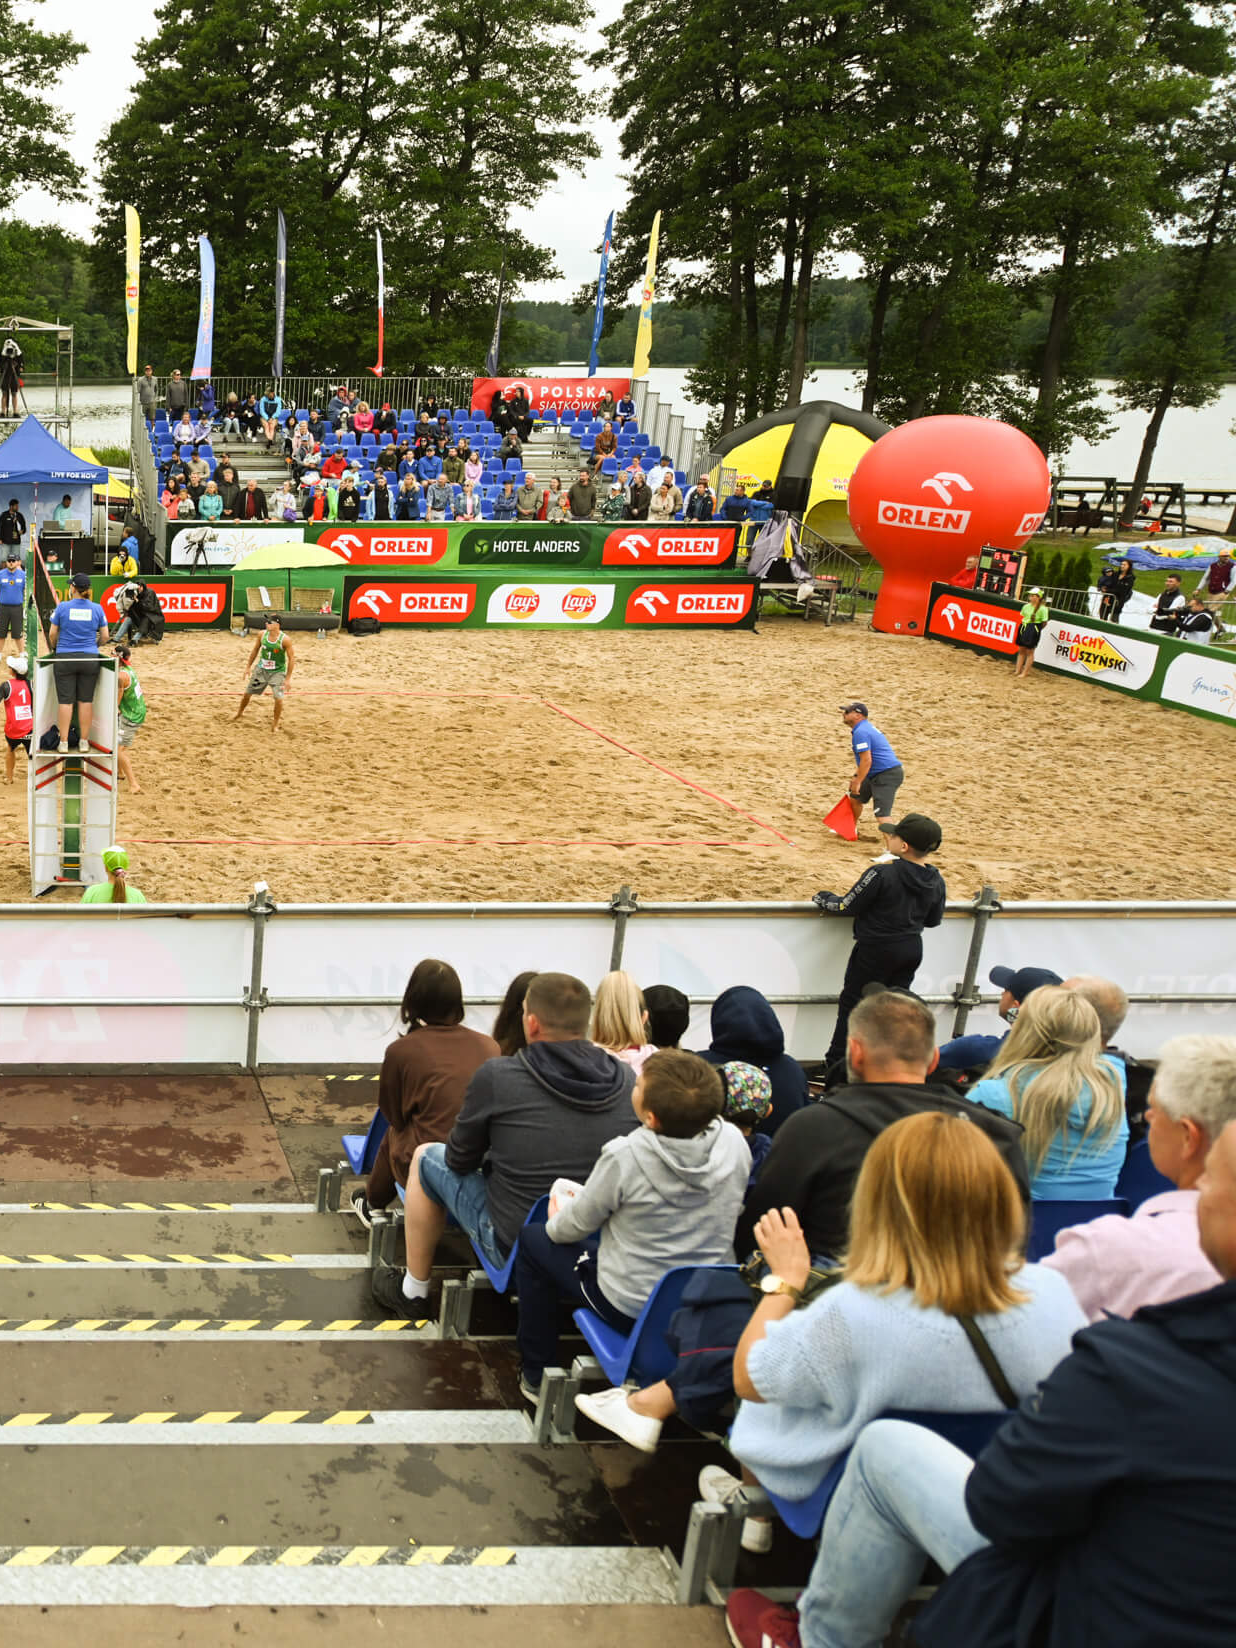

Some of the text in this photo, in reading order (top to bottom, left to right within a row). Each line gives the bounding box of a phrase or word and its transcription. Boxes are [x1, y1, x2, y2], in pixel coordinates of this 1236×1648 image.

[541, 387, 607, 398] POLSKA
[539, 398, 598, 410] SIATKÓWK
[881, 505, 963, 531] ORLEN
[373, 540, 428, 552] ORLEN
[493, 540, 580, 553] HOTEL ANDERS
[661, 540, 715, 553] ORLEN
[158, 596, 213, 609] ORLEN
[405, 597, 463, 610] ORLEN
[507, 594, 540, 612] Lay's
[563, 594, 596, 612] Lay's
[681, 597, 739, 610] ORLEN
[970, 614, 1012, 640] ORLEN
[1058, 629, 1105, 650] BLACHY
[1055, 645, 1127, 672] PRUSZYŃSKI
[18, 689, 26, 704] 1
